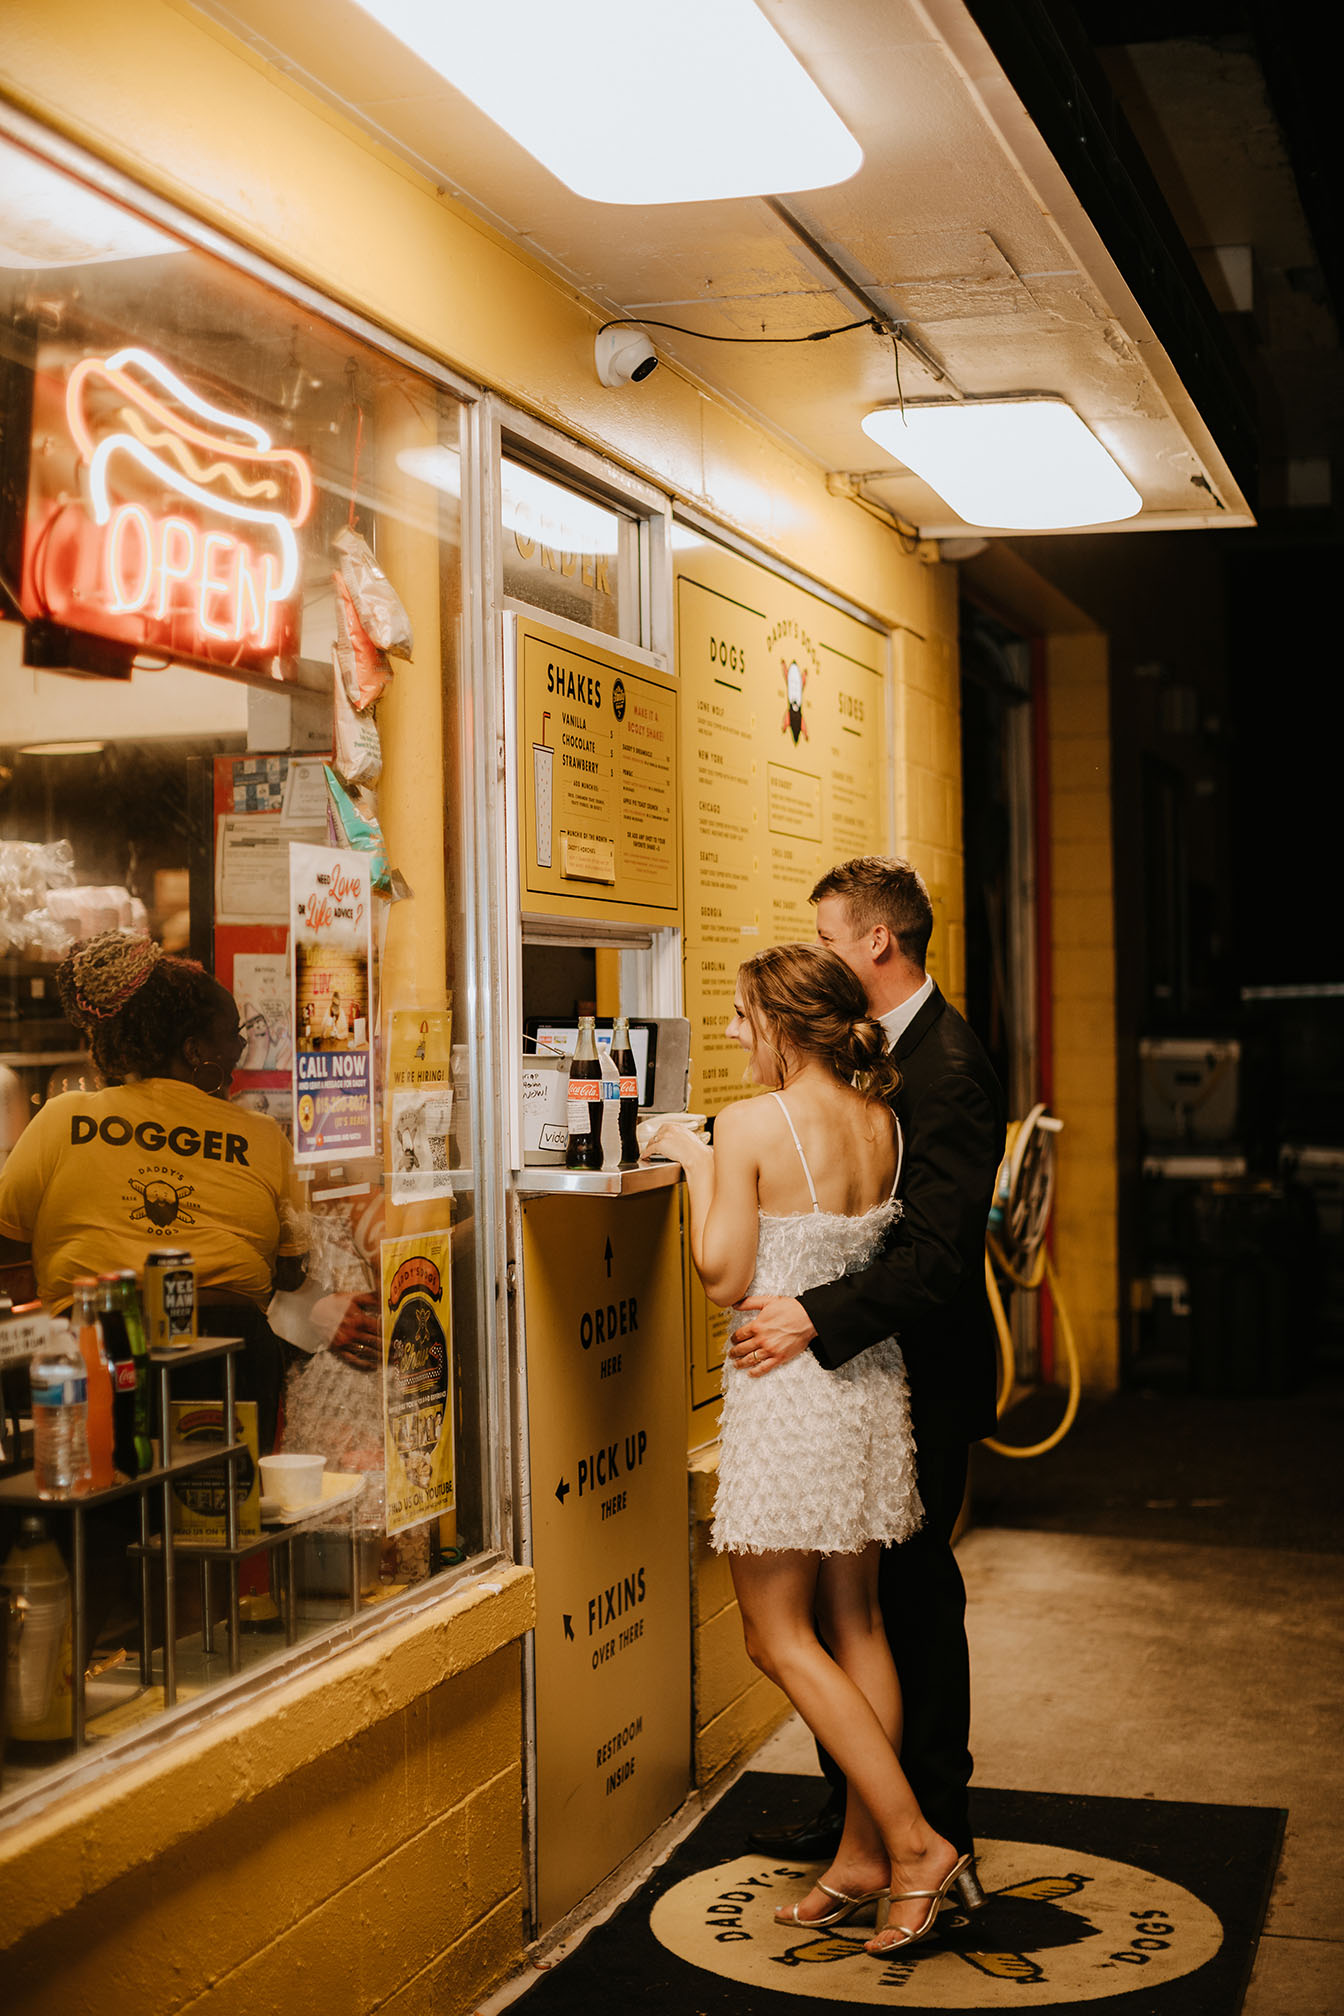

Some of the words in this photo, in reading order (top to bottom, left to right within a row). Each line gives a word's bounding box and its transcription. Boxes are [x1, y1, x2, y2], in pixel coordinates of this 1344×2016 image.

[107, 504, 275, 648] OPEN
[709, 636, 745, 674] DOGS
[547, 663, 601, 709] SHAKES
[838, 691, 864, 722] SIDES
[561, 712, 587, 730] VANILLA
[562, 733, 595, 753] CHOCOLATE
[562, 754, 599, 774] STRAWBERRY
[698, 749, 709, 761] NEW
[711, 753, 724, 765] YORK
[698, 801, 721, 814] CHICAGO
[699, 850, 719, 863] SEATTLE
[317, 873, 331, 885] NEED
[329, 863, 361, 903] Love
[298, 904, 305, 915] OR
[306, 893, 333, 934] Life
[701, 905, 722, 918] GEORGIA
[701, 961, 725, 971] CAROLINA
[702, 1016, 717, 1026] MUSIC
[719, 1015, 729, 1025] CITY
[299, 1056, 328, 1079] CALL
[332, 1055, 366, 1077] NOW
[394, 1071, 414, 1083] WE'RE
[417, 1069, 445, 1083] HIRING!
[718, 1067, 729, 1078] DOG
[298, 1081, 309, 1090] AND
[70, 1115, 250, 1166] DOGGER
[138, 1165, 184, 1182] DADDY'S
[165, 1280, 192, 1294] YEE
[393, 1268, 420, 1294] DADDY'S
[419, 1269, 437, 1288] DOGS
[165, 1294, 192, 1308] HAW
[579, 1296, 639, 1350] ORDER
[600, 1353, 622, 1379] HERE
[577, 1442, 620, 1497] PICK
[625, 1430, 647, 1473] UP
[403, 1497, 413, 1510] US
[413, 1493, 424, 1506] ON
[425, 1480, 453, 1501] YOUTUBE
[601, 1490, 627, 1521] THERE
[587, 1567, 646, 1636] FIXINS
[591, 1638, 616, 1670] OVER
[618, 1618, 645, 1652] THERE
[596, 1716, 643, 1769] RESTROOM
[605, 1757, 636, 1796] INSIDE
[705, 1867, 807, 1943] DADDY'S
[1108, 1909, 1175, 1966] DOGS
